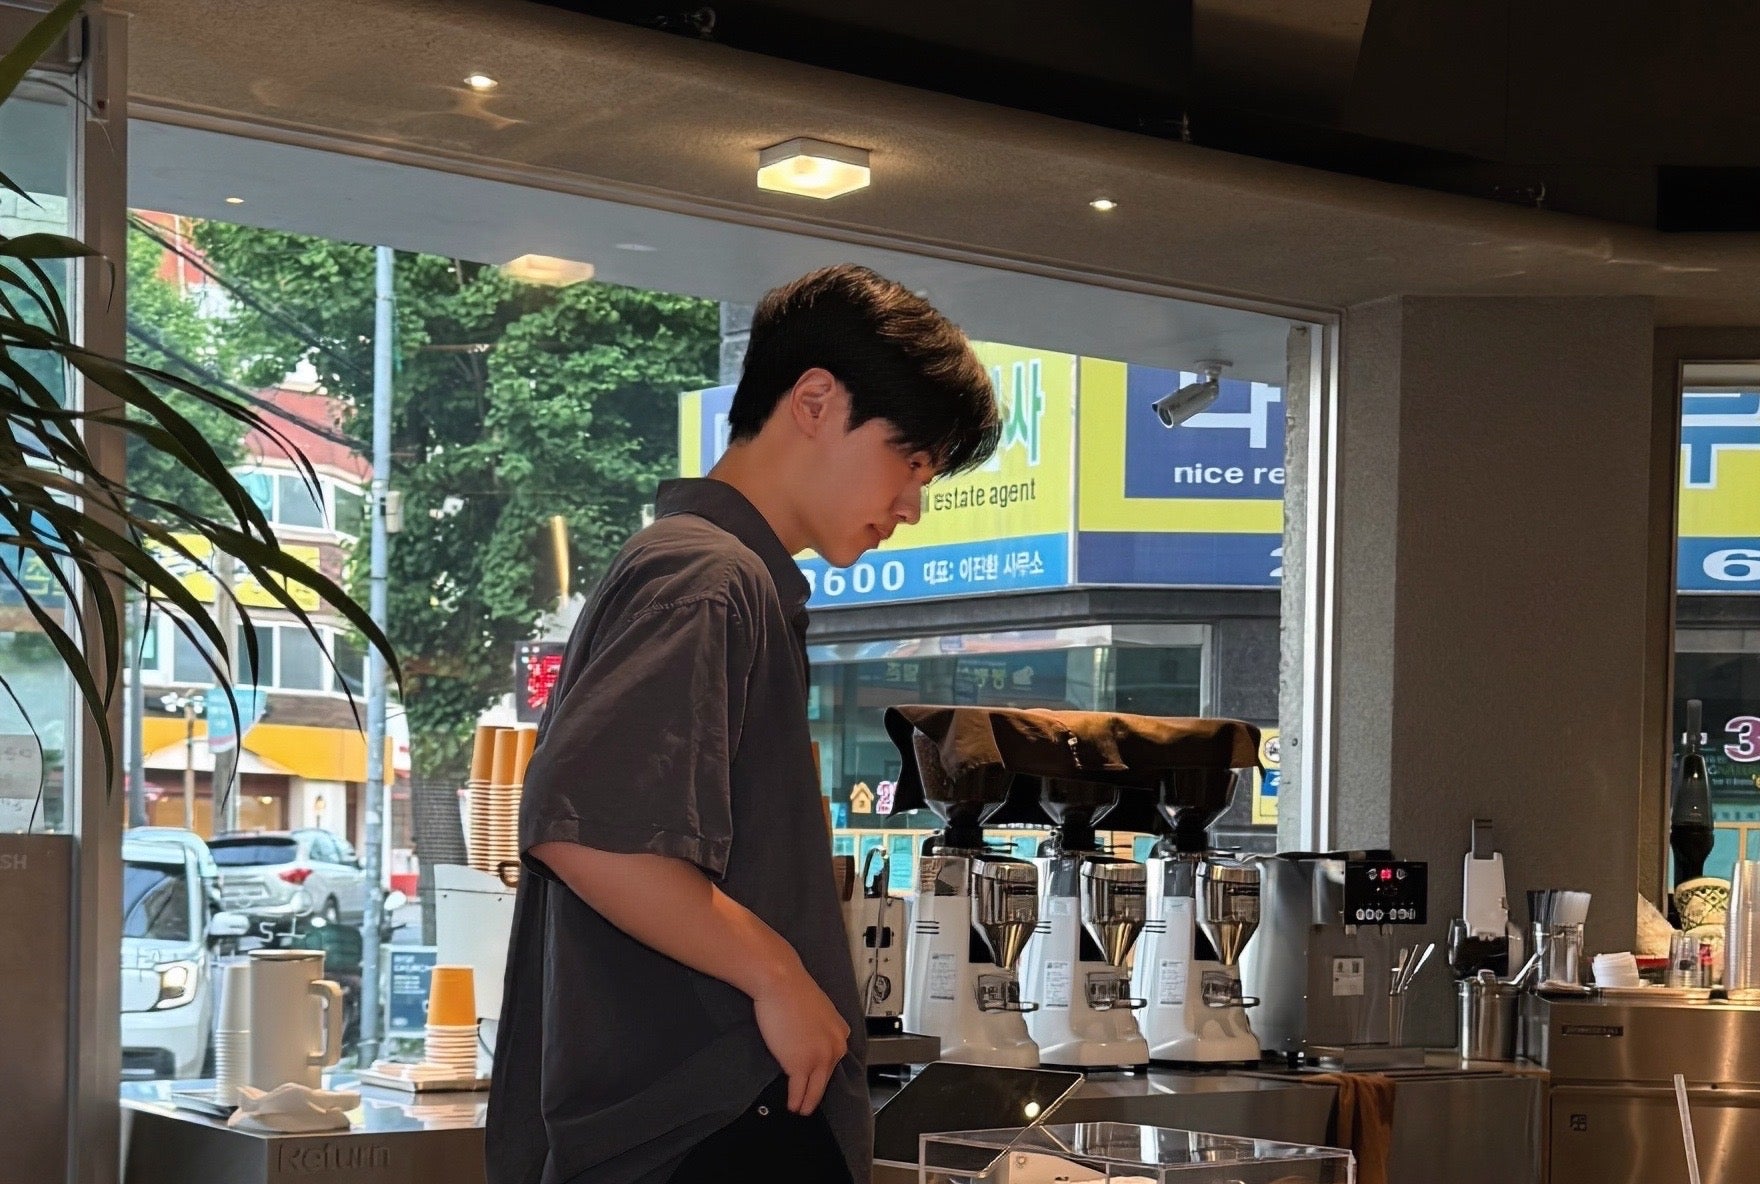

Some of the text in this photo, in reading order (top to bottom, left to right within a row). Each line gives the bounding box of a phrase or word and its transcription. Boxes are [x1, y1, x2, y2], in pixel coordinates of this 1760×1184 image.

[1174, 463, 1244, 485] nice
[933, 485, 985, 512] estate
[989, 478, 1036, 508] agent
